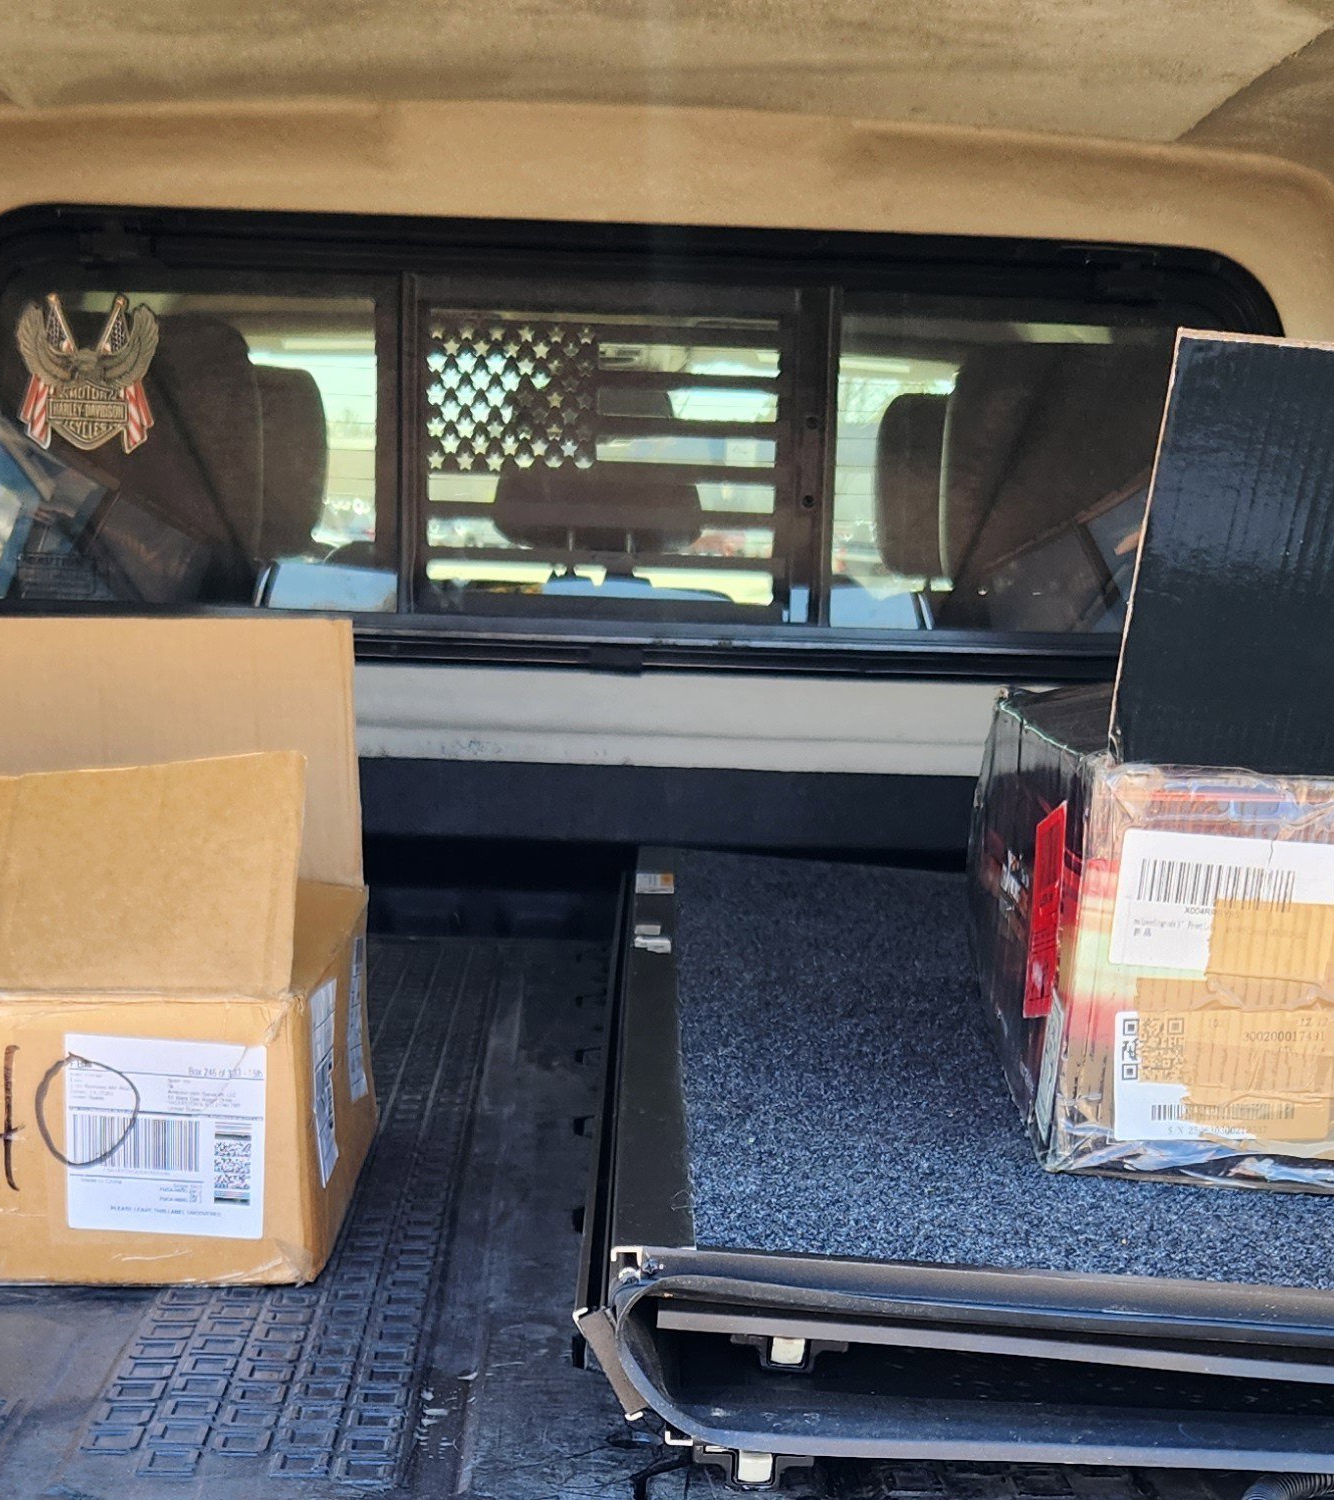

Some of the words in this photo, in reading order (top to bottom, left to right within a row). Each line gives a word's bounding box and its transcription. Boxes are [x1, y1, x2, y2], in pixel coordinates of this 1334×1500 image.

[67, 385, 110, 400] MOTOR
[52, 403, 126, 419] HARLEY-DAVIDSON
[69, 420, 109, 437] CYCLES
